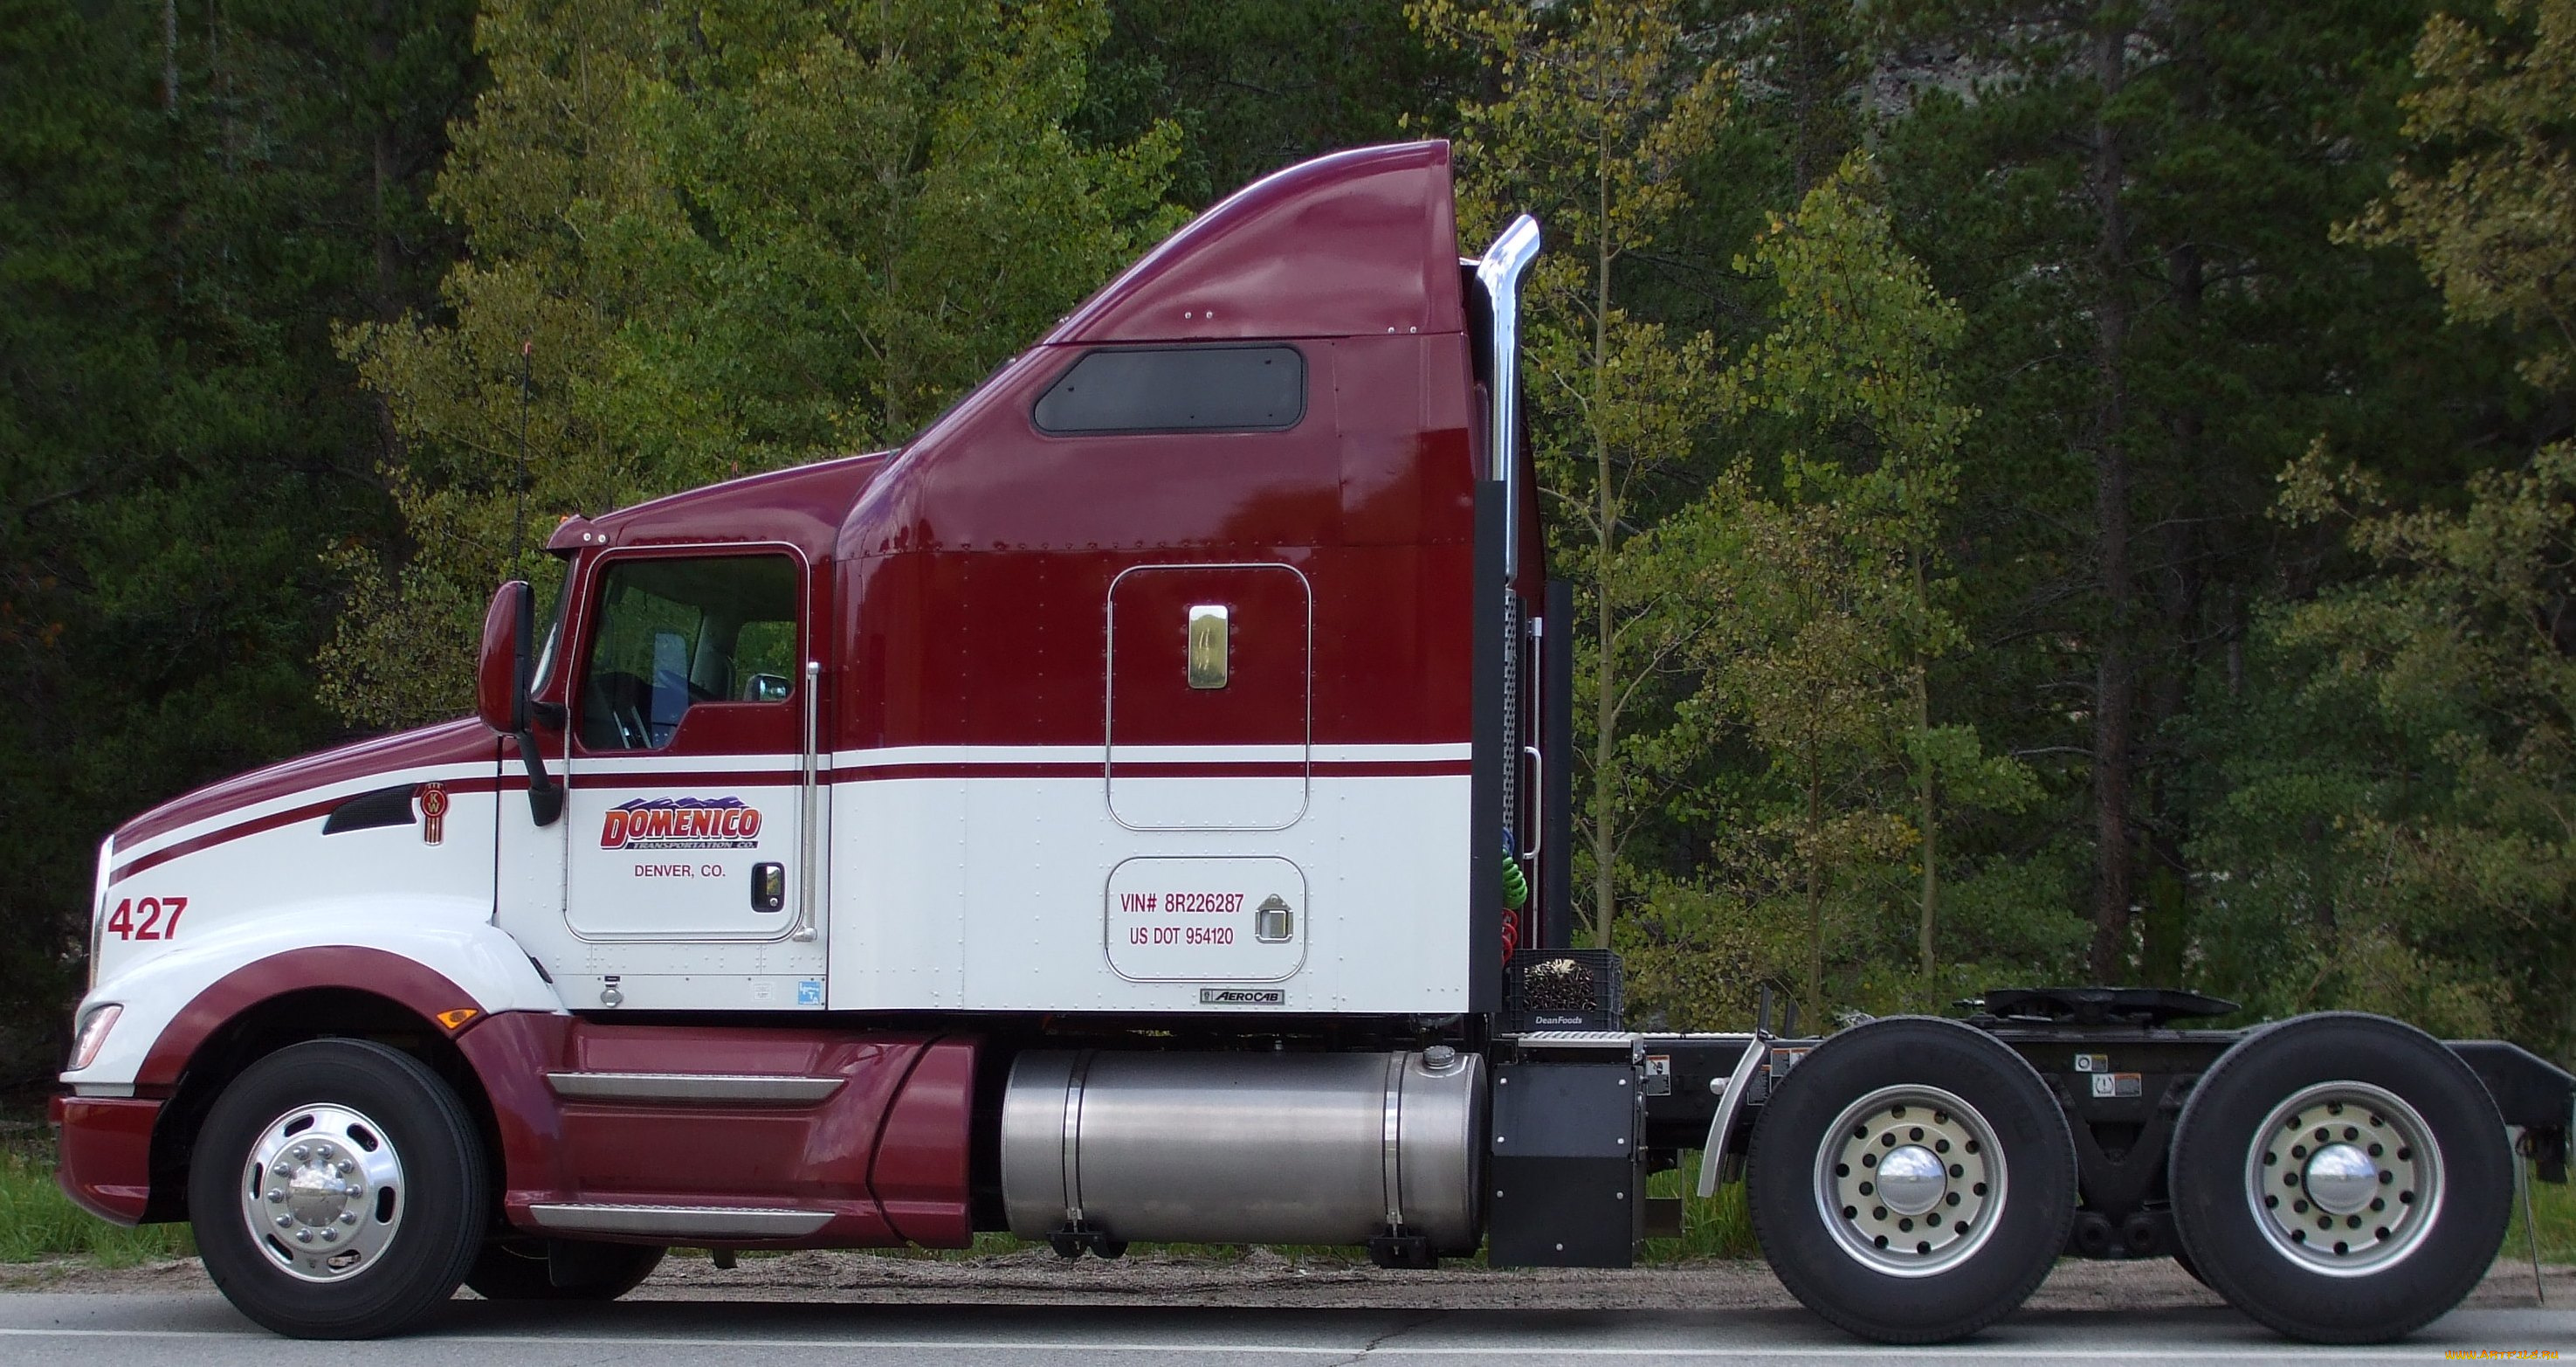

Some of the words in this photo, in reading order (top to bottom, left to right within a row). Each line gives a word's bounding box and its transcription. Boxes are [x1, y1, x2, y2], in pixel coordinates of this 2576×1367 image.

[600, 807, 762, 850] DOMENICO
[635, 865, 694, 878] DENVER,
[700, 865, 726, 877] CO.
[1121, 894, 1157, 912] VIN#
[1165, 894, 1243, 913] 8R226287
[108, 897, 188, 941] 427
[1130, 928, 1147, 944] US
[1154, 928, 1180, 944] DOT
[1186, 928, 1233, 944] 954120
